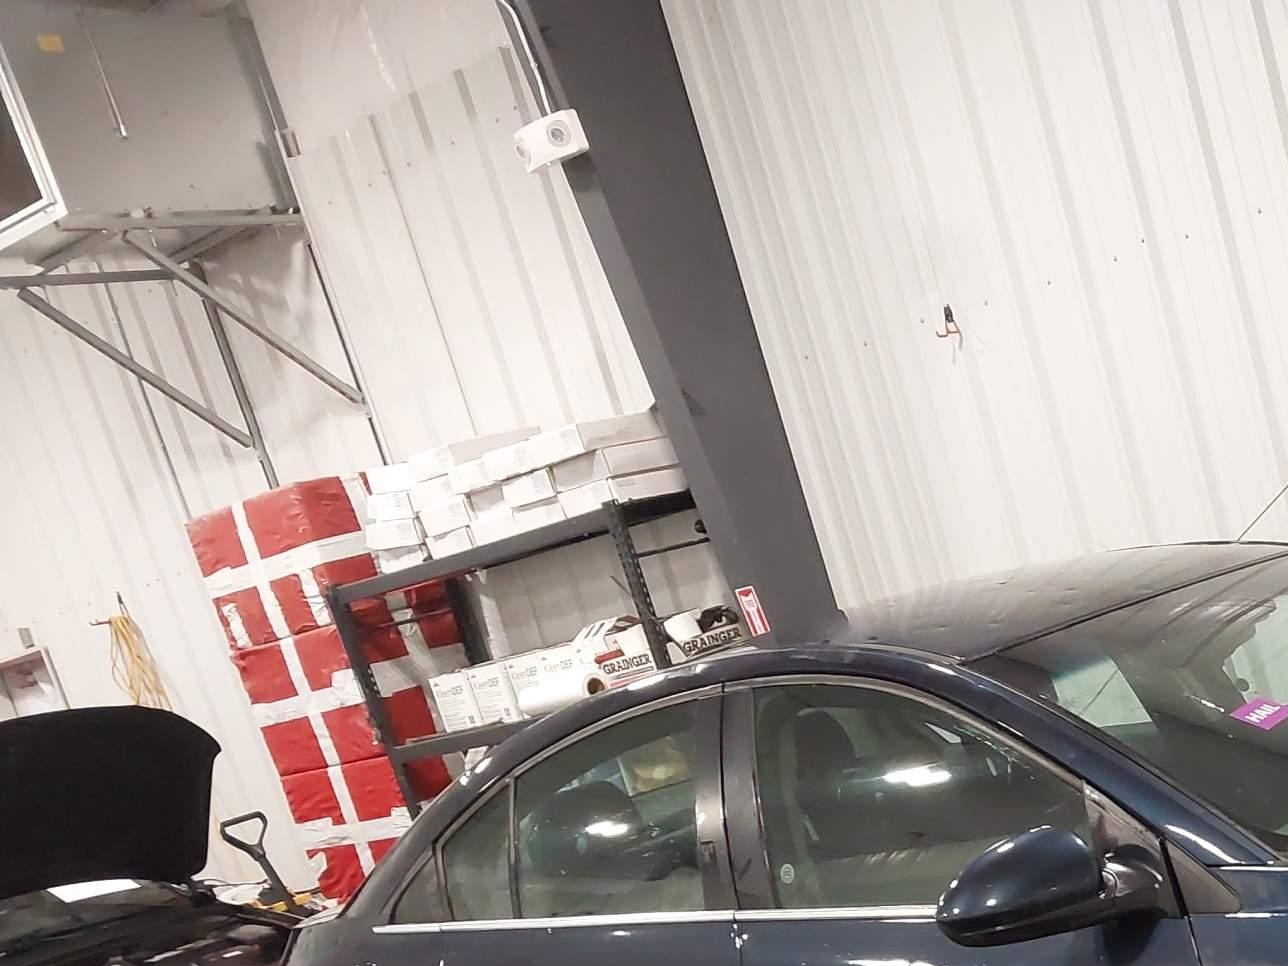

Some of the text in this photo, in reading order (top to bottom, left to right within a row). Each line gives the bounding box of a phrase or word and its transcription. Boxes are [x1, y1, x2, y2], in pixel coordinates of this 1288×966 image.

[683, 627, 742, 653] GRAINGER
[602, 653, 652, 675] GRAINGER
[1244, 703, 1281, 723] HAIL
